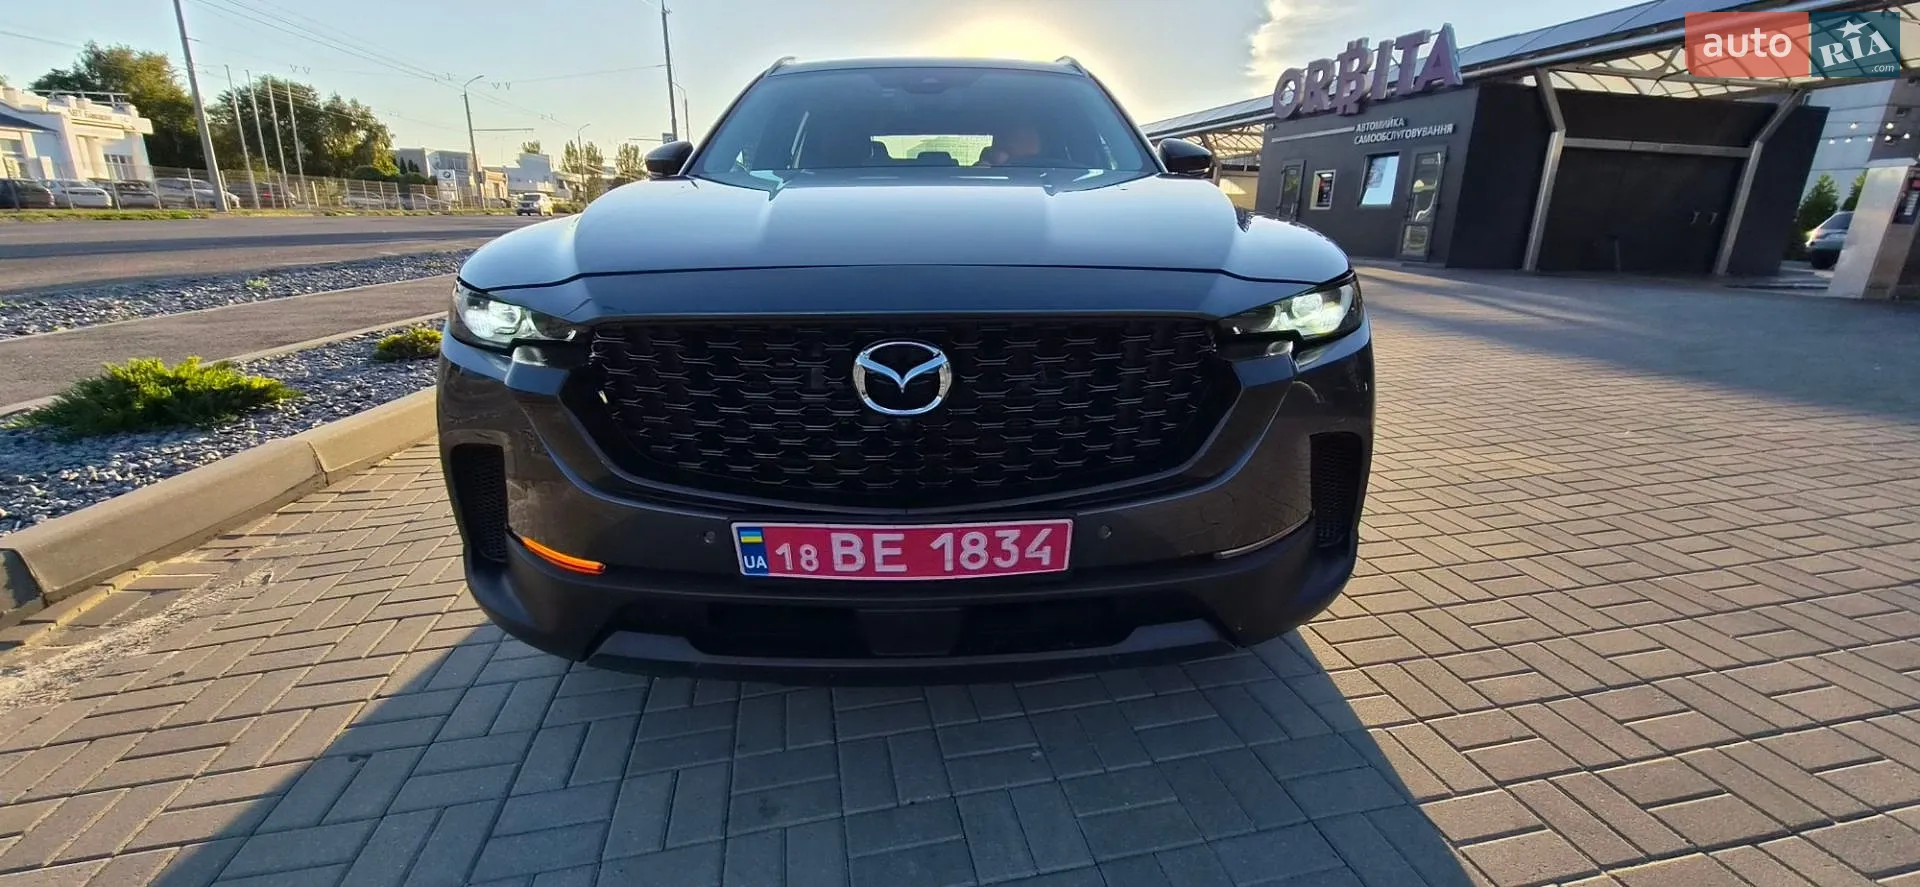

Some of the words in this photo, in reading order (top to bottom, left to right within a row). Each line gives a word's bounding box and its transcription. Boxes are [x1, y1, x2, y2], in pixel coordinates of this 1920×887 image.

[1353, 123, 1454, 145] САМООБСЛУГОВУВАННЯ
[1354, 117, 1405, 133] АВТОМИЙКА
[743, 556, 768, 570] UA
[775, 542, 820, 573] 18
[830, 532, 908, 574] BE
[929, 527, 1053, 572] 1834
